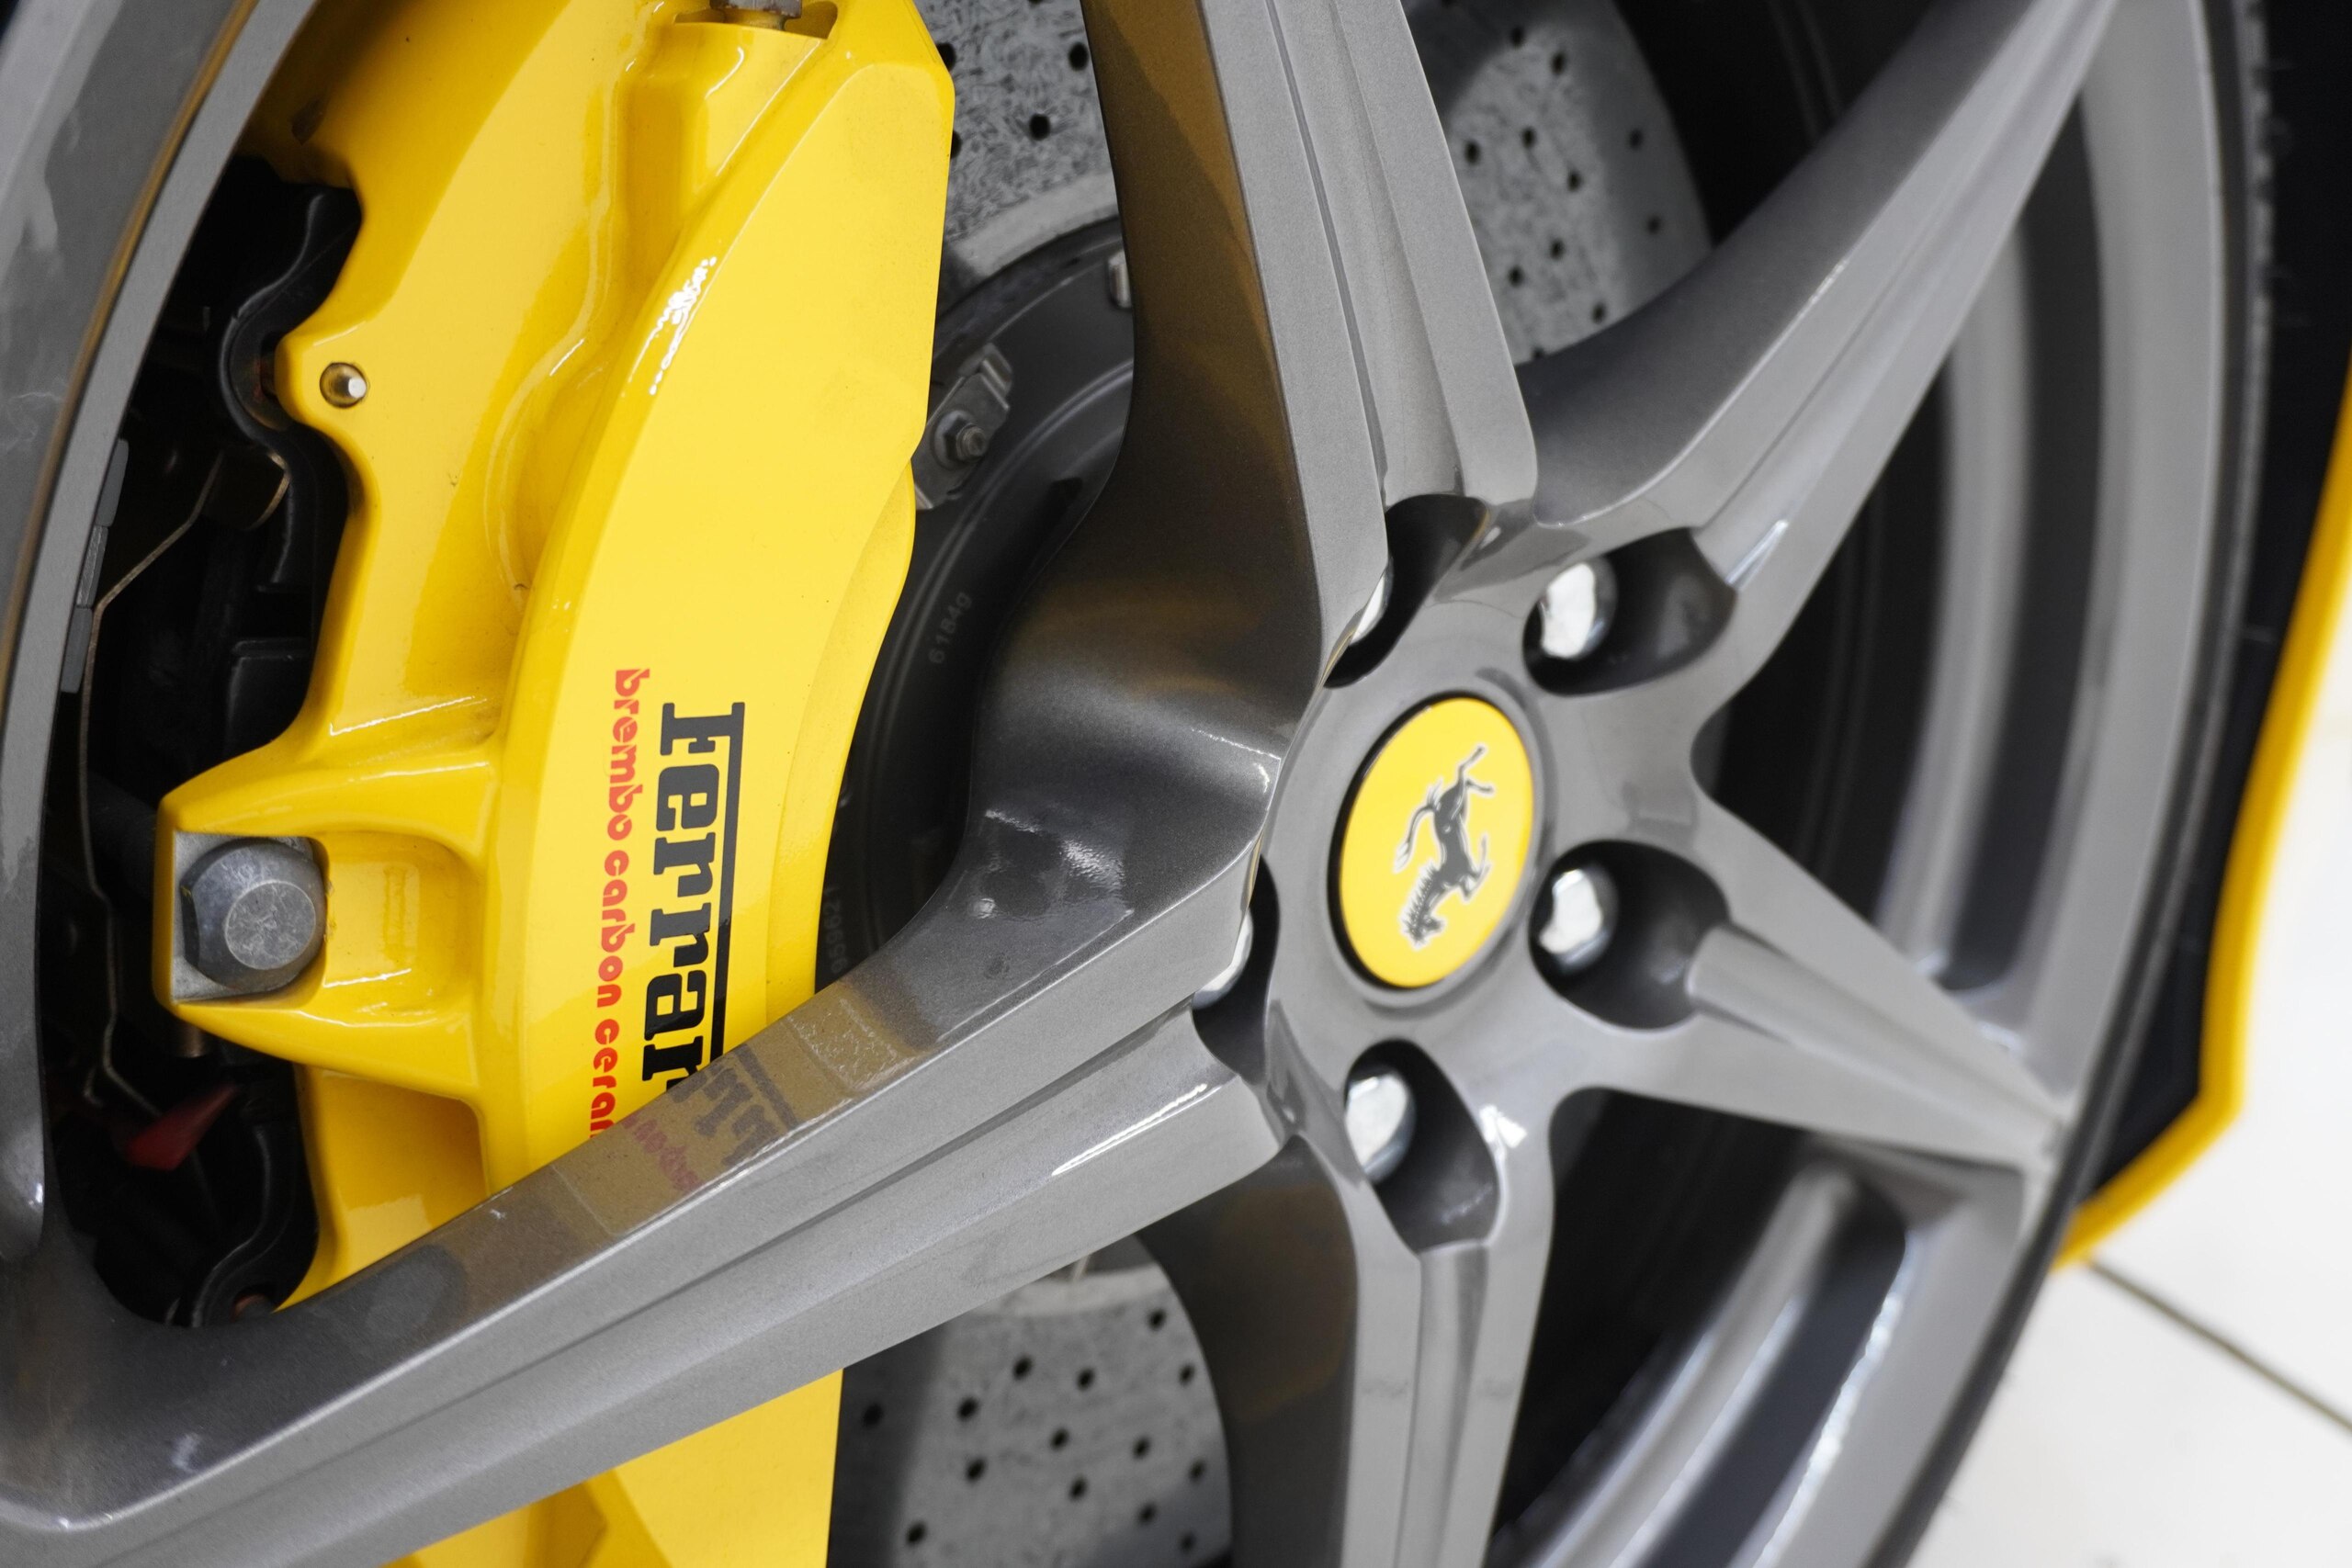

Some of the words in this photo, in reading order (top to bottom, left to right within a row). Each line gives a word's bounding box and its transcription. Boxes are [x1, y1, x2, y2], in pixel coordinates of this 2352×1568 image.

[607, 668, 650, 841] brembo
[596, 850, 636, 1009] carbon
[642, 702, 745, 1090] Ferrar
